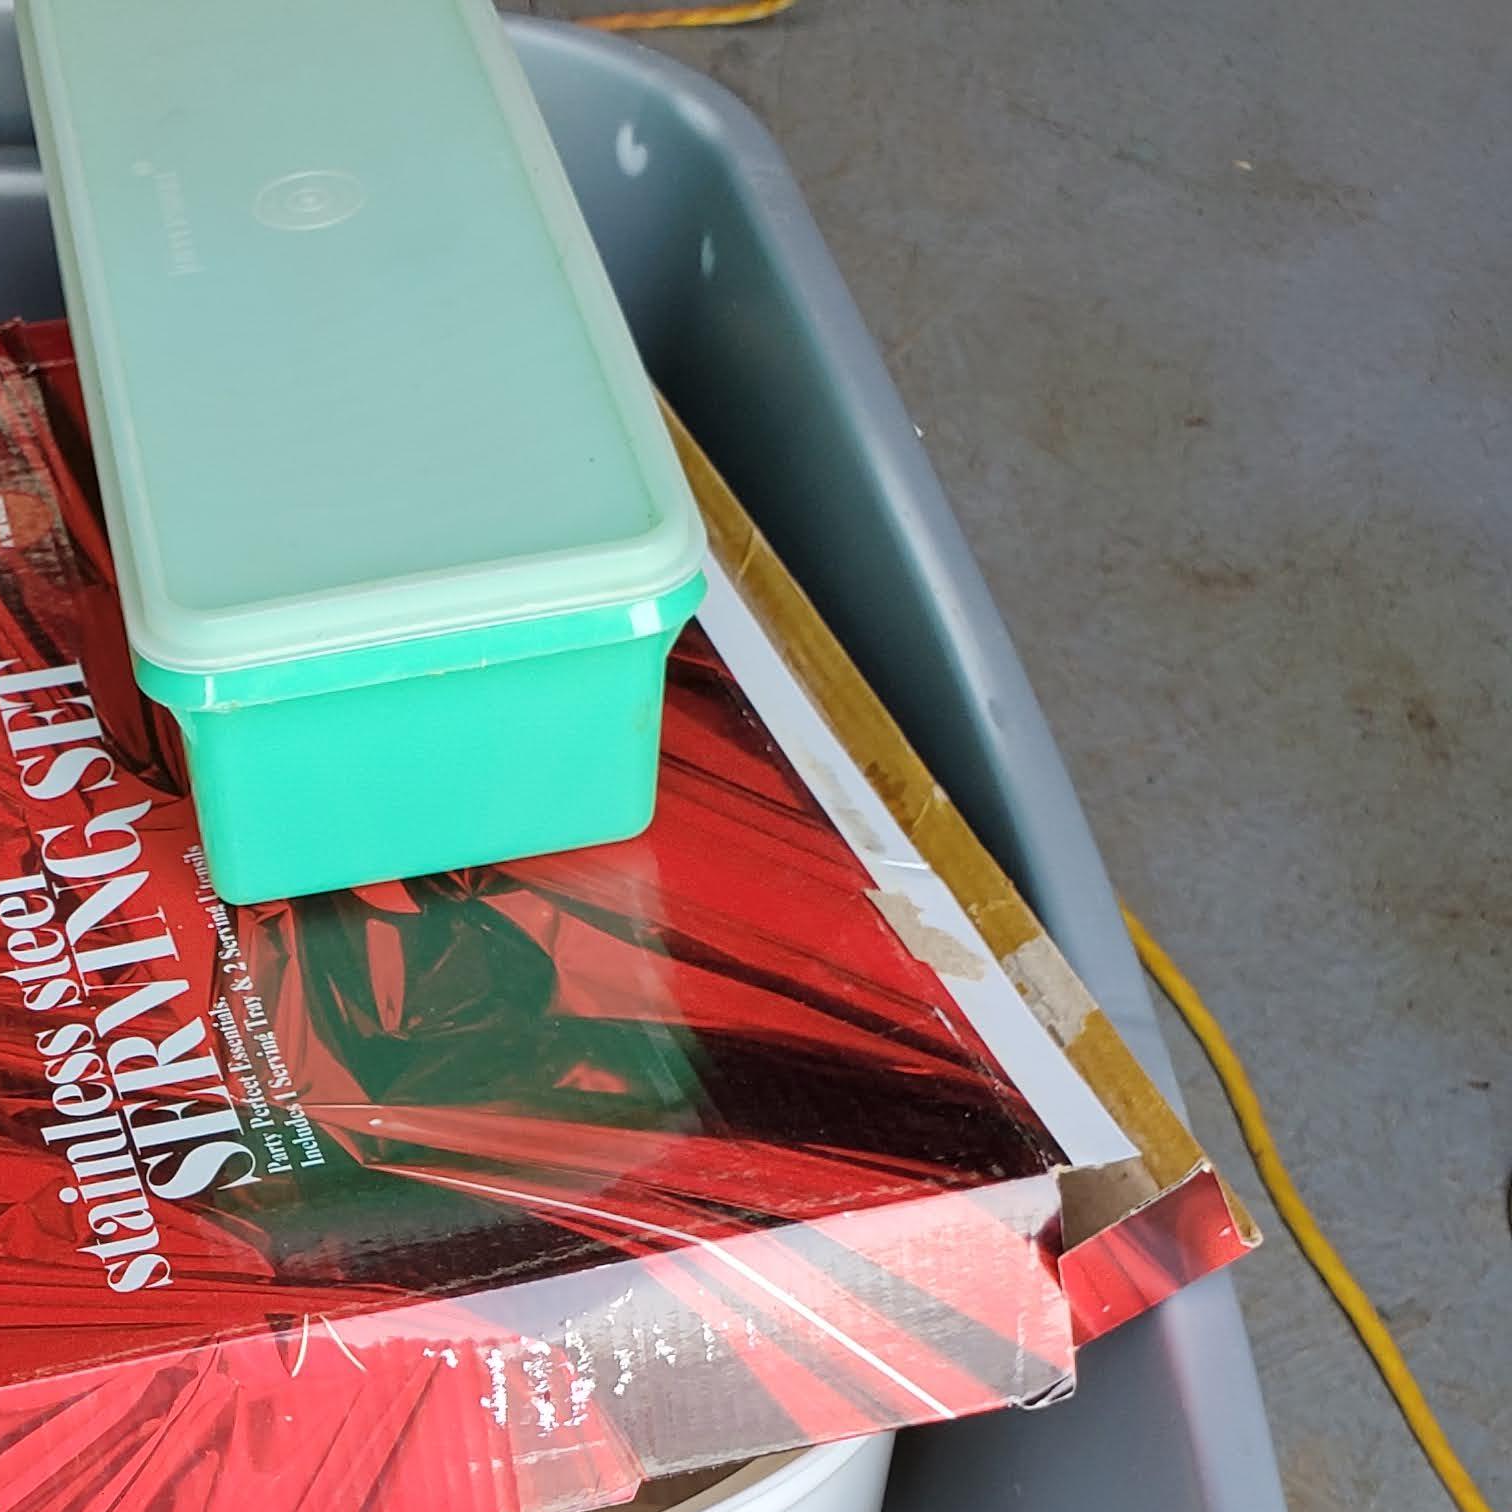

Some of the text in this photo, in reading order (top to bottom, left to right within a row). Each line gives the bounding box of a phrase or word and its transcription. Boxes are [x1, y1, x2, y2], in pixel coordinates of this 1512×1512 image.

[206, 902, 242, 960] Serving
[224, 961, 247, 975] 2
[230, 978, 254, 993] &
[36, 800, 262, 1199] SERVING
[244, 995, 268, 1033] Tray
[208, 996, 292, 1173] Party Perfect Essentials.
[254, 1031, 292, 1090] Serving
[275, 1091, 297, 1102] 1
[35, 1024, 174, 1293] stainless
[284, 1102, 325, 1168] Includes
